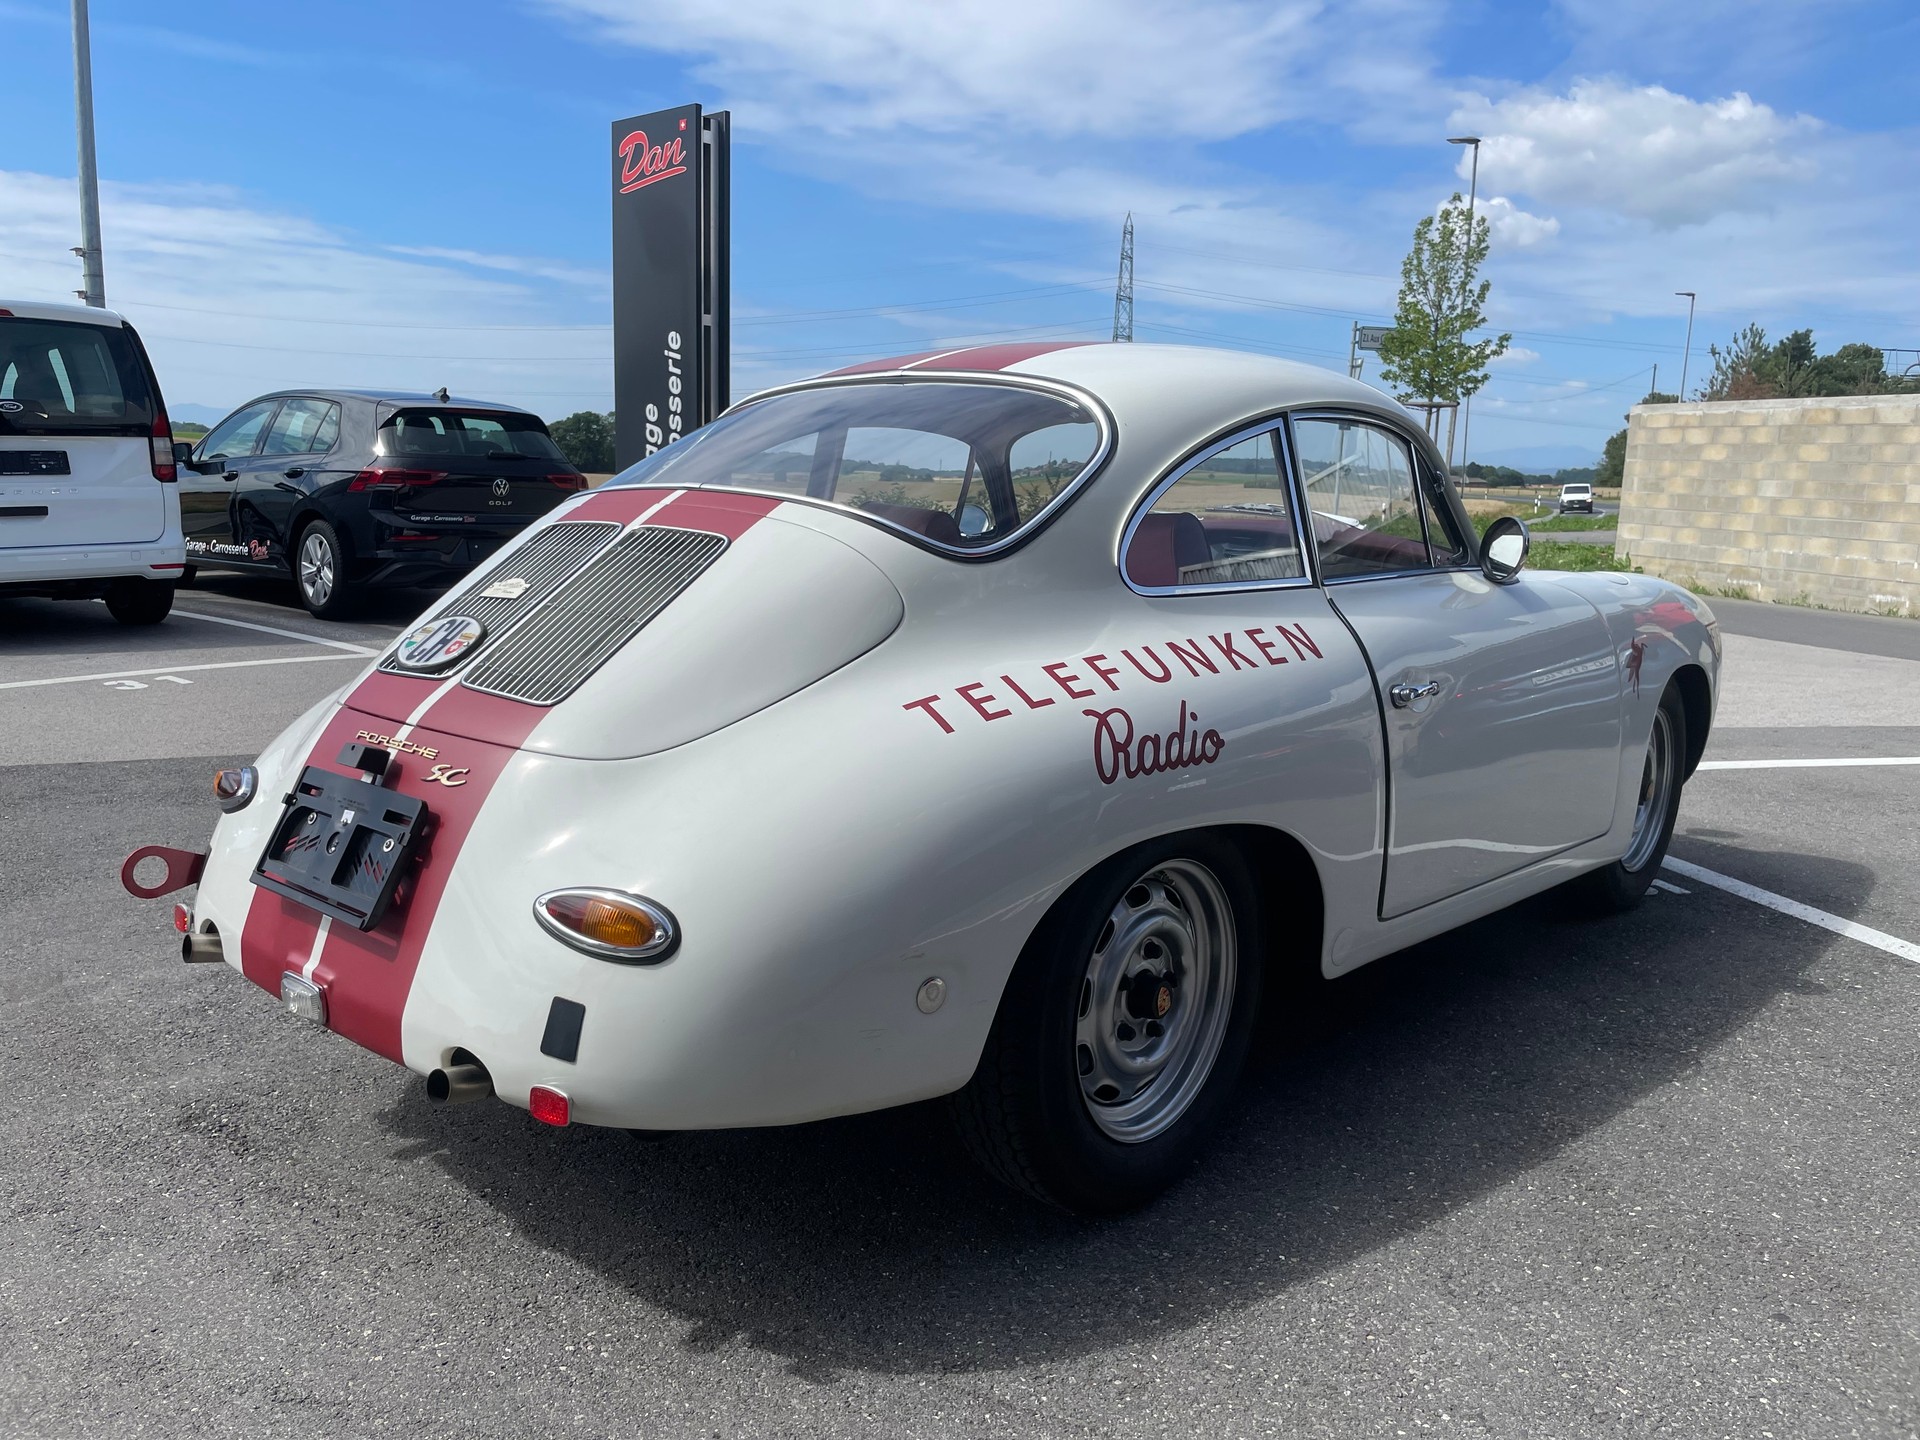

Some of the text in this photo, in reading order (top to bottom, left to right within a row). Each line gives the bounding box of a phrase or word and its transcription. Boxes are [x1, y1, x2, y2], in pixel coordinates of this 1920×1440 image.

[618, 130, 687, 189] Dan
[185, 537, 206, 554] Garage
[210, 539, 249, 556] Carrosserie
[406, 619, 472, 662] CH
[902, 622, 1325, 735] TELEFUNKEN
[355, 730, 440, 760] PORSCHE
[1082, 700, 1225, 785] Radio
[421, 763, 470, 788] SC
